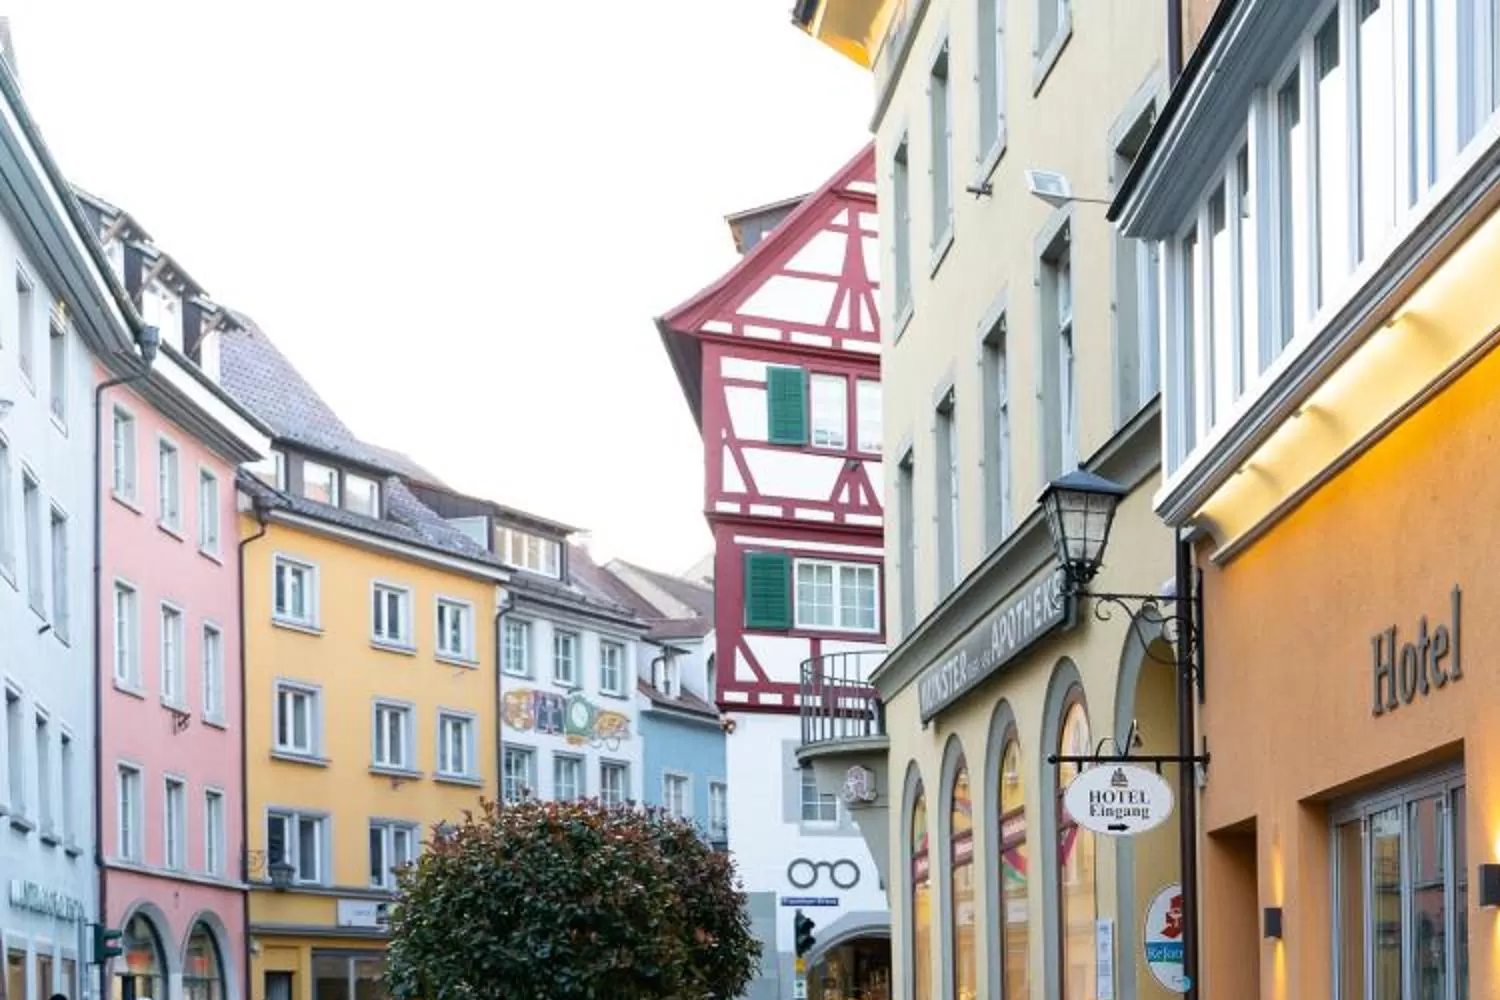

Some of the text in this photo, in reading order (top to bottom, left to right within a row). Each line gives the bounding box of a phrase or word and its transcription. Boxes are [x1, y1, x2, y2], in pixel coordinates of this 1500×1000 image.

[1371, 583, 1463, 718] Hotel
[1089, 789, 1151, 804] HOTEL
[1089, 804, 1151, 820] Eingang
